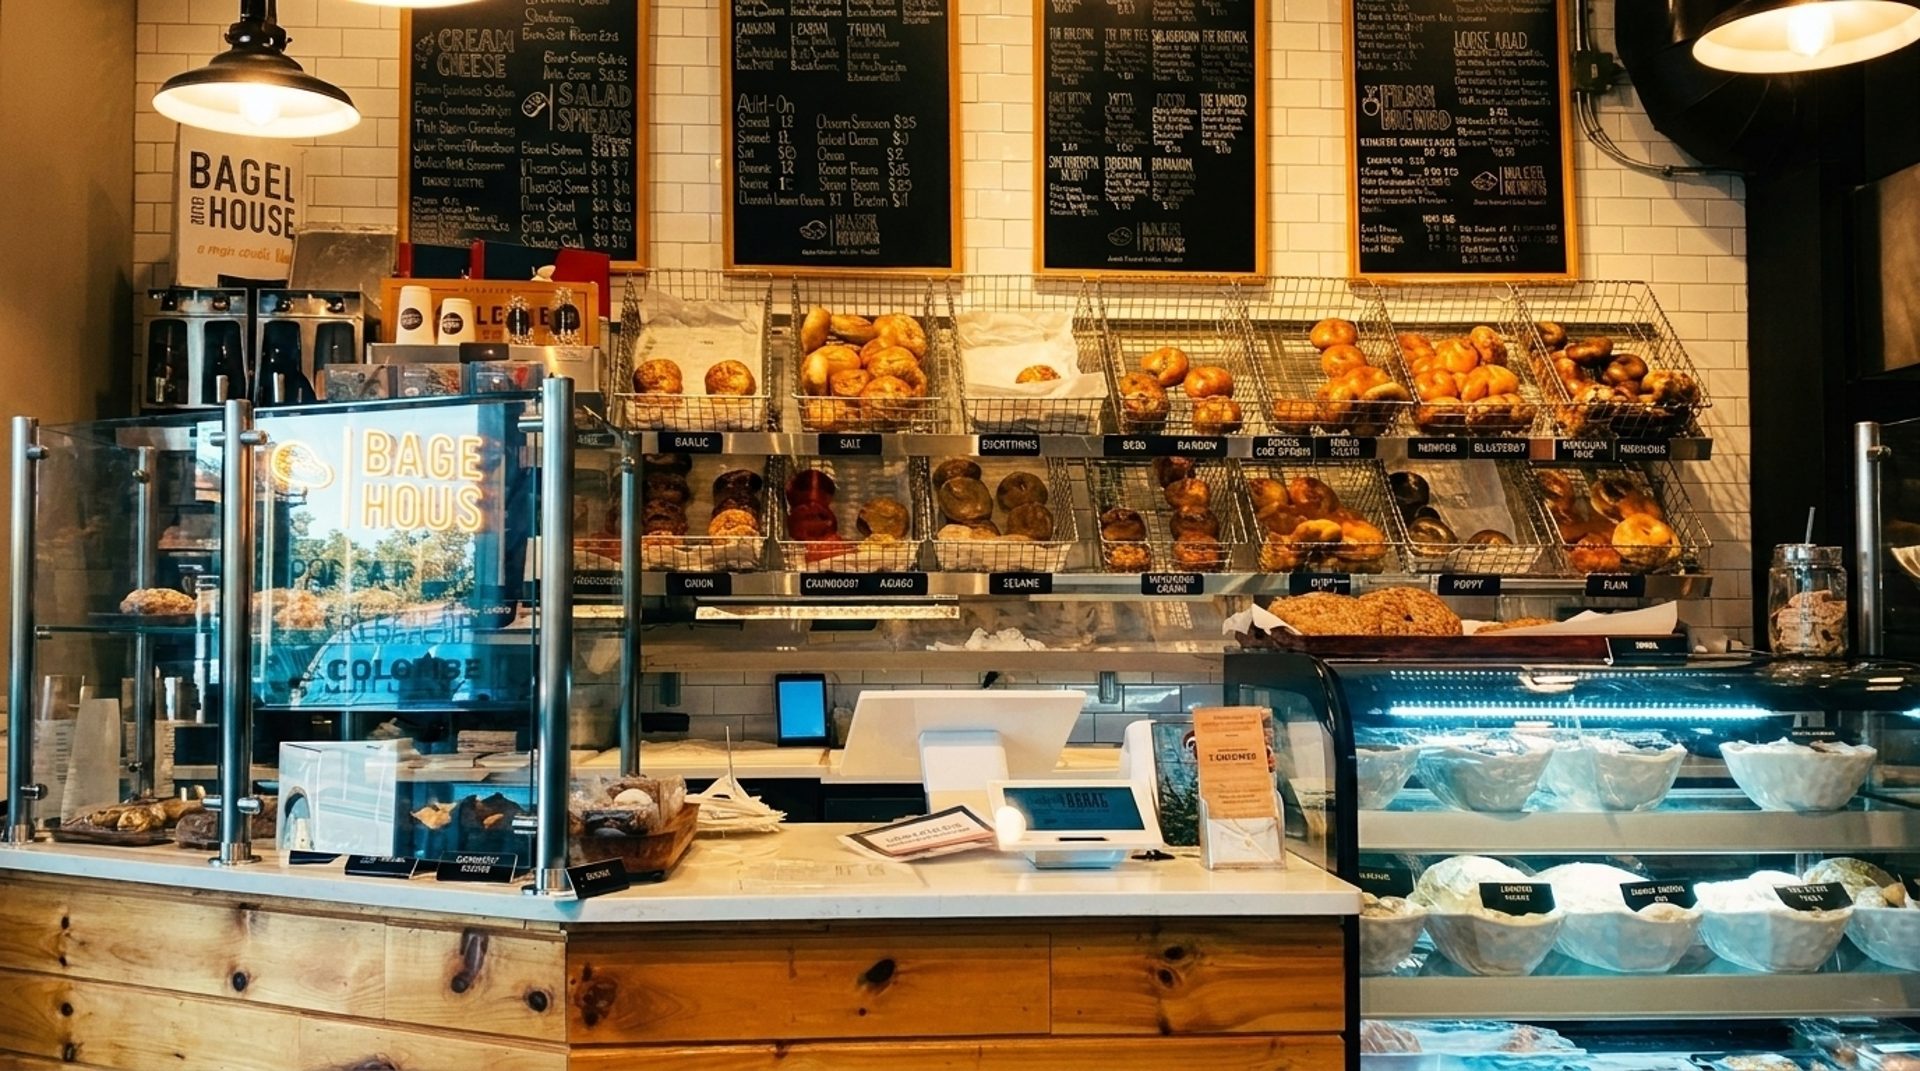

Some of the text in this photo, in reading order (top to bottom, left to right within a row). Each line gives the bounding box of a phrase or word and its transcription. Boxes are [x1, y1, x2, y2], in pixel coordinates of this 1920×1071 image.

[558, 82, 632, 107] SALAD
[190, 151, 295, 203] BAGEL
[209, 196, 295, 240] HOUSE
